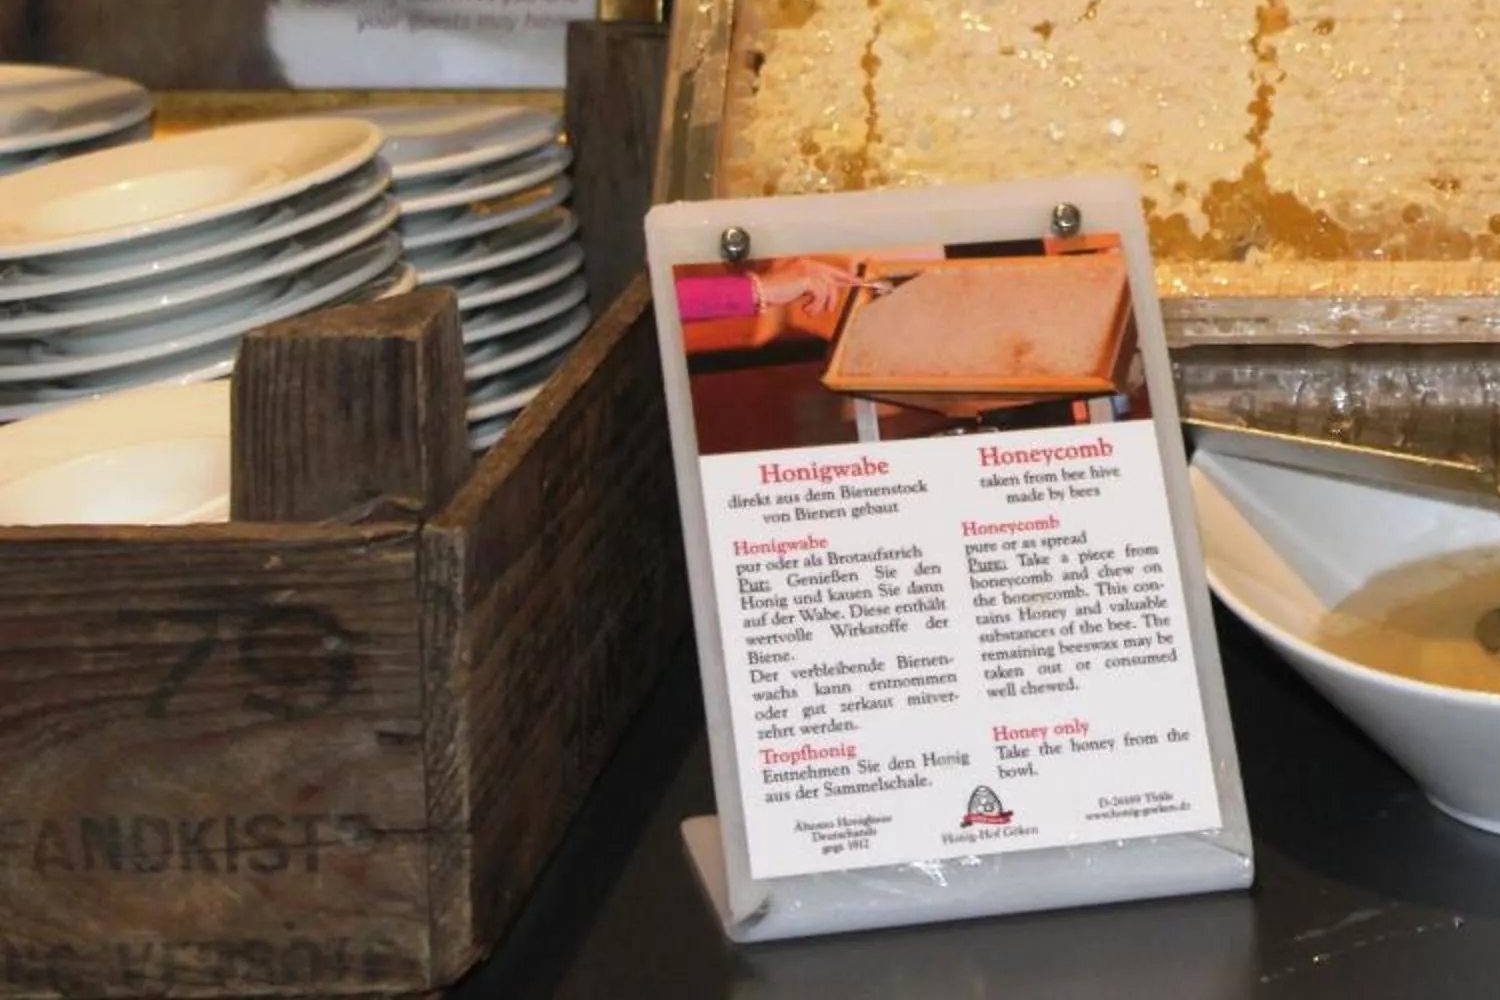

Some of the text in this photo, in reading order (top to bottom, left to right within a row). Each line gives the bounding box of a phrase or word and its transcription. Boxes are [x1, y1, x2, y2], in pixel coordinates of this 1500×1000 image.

[979, 438, 1113, 466] Honeycomb
[759, 457, 889, 484] Honigwabe
[980, 465, 1120, 487] taken from bee hive
[728, 481, 928, 509] direkt aus dem Bienenstock
[1006, 486, 1100, 504] made by bees
[763, 502, 898, 524] von Bienen gebaut
[961, 516, 1060, 537] Honeycomb
[733, 535, 829, 557] Honigwabe
[965, 531, 1087, 556] pure or as spread
[1018, 552, 1051, 567] Take
[1061, 554, 1068, 563] a
[1079, 548, 1115, 564] piece
[1125, 544, 1159, 557] from
[736, 545, 923, 576] pur oder als Brotaufstrich
[787, 571, 859, 587] Genießen
[875, 566, 897, 579] Sie
[914, 562, 941, 576] den
[970, 563, 1162, 590] honeycomb and chew on
[741, 582, 944, 610] Honig und kauen Sie dann
[973, 581, 1164, 607] the honeycomb. This con-
[743, 598, 946, 628] auf der Wabe. Diese enthält
[976, 595, 1167, 625] tains Honey and valuable
[745, 617, 949, 646] wertvolle Wirkstoffe der
[979, 613, 1170, 644] substances of the bee. The
[748, 652, 794, 665] Biene.
[981, 632, 1174, 661] remaining beeswax may be
[751, 654, 954, 683] Der verbleibende Bienen-
[984, 649, 1177, 679] taken out or consumed
[752, 674, 957, 702] wachs kann entnommen
[986, 677, 1079, 698] well chewed.
[755, 691, 959, 720] oder gut zerkaut mitver-
[757, 719, 859, 740] zehrt werden.
[993, 719, 1089, 742] Honey only
[760, 743, 857, 765] Tropfhonig
[995, 728, 1190, 760] Take the honey from the
[763, 751, 970, 784] Entnehmen Sie den Honig
[998, 763, 1038, 778] bowl.
[765, 775, 932, 803] aus der Sammelschale.
